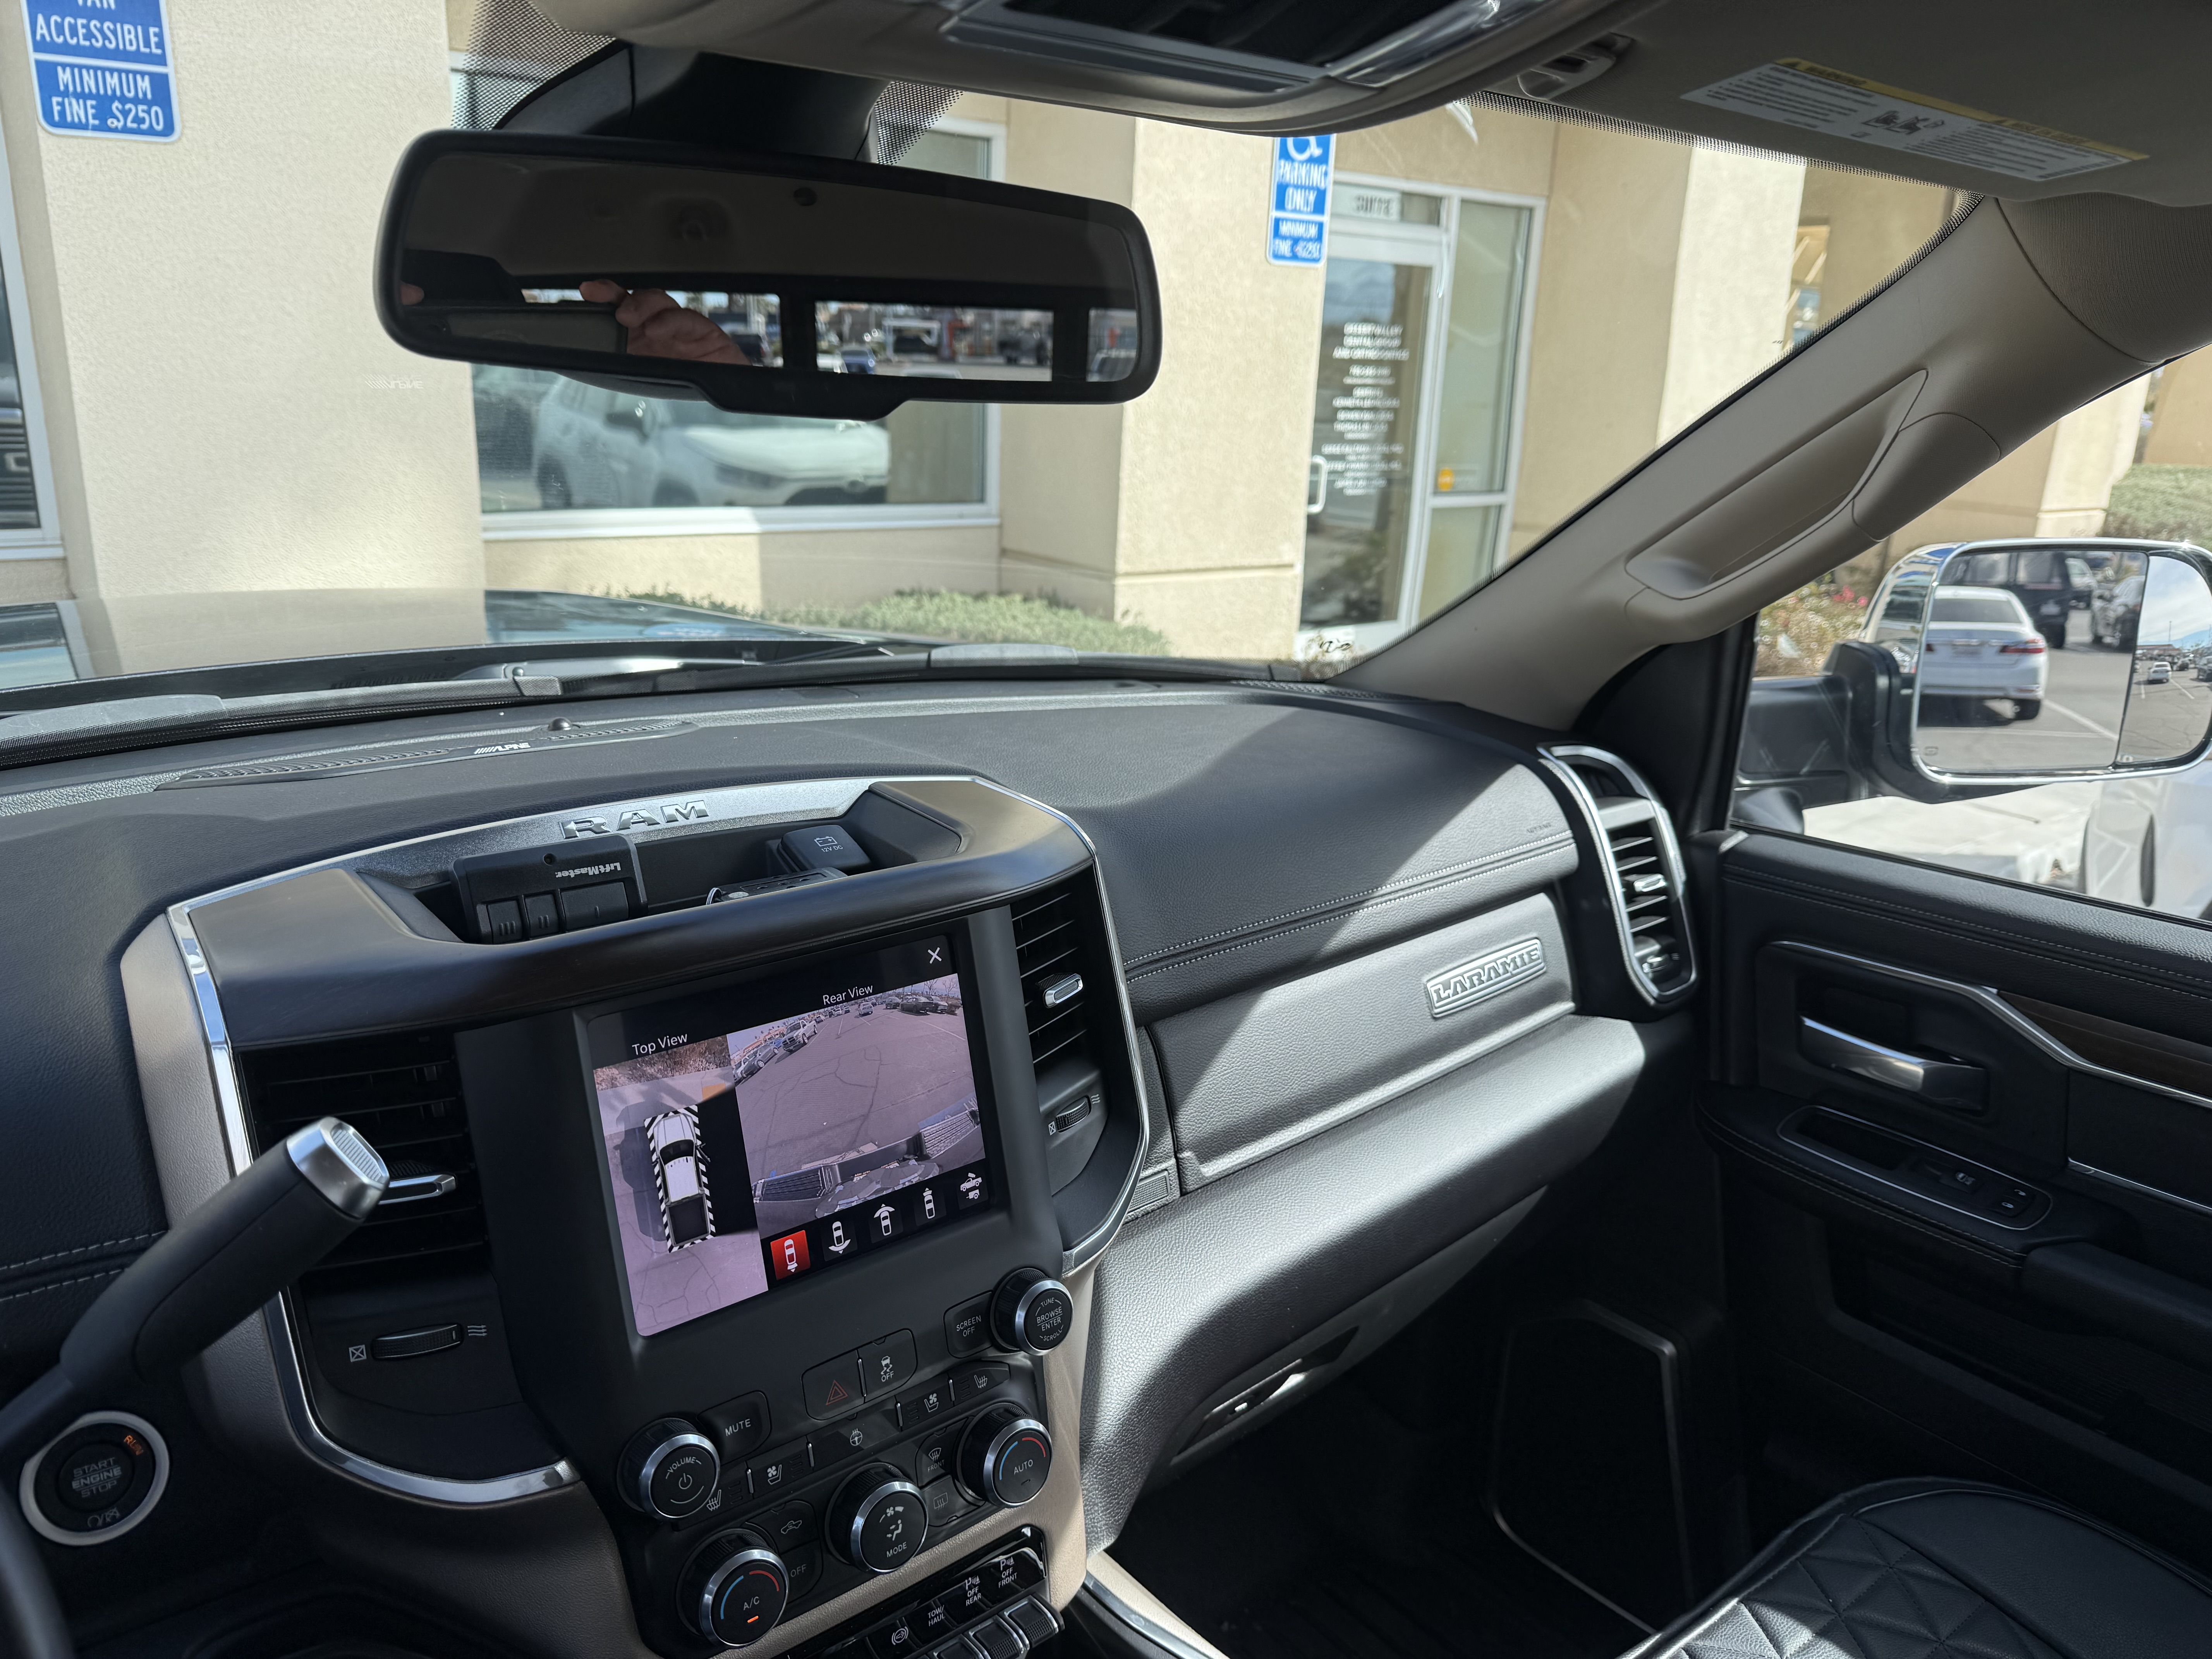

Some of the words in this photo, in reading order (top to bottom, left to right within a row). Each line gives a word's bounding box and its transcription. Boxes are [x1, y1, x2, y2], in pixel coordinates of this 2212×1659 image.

[35, 13, 163, 55] ACCESSIBLE
[57, 66, 152, 100] MINIMUM
[51, 96, 100, 125] FINE
[111, 100, 164, 131] $250
[559, 800, 709, 839] RAM
[1434, 948, 1540, 1003] LARAMIE
[823, 994, 848, 1005] Rear
[848, 985, 873, 998] View
[632, 1043, 656, 1056] Top
[658, 1033, 688, 1049] View
[1040, 1297, 1055, 1308] TUNE
[956, 1315, 981, 1331] SCREEN
[1036, 1306, 1063, 1324] BROWSE
[963, 1326, 975, 1337] OFF
[1041, 1317, 1061, 1331] ENTER
[1043, 1329, 1063, 1342] SCROLL
[881, 1371, 894, 1382] OFF
[725, 1418, 751, 1437] MUTE
[124, 1435, 144, 1456] RUN
[73, 1457, 115, 1478] START
[667, 1456, 697, 1474] VOLUME
[927, 1459, 945, 1472] FRONT
[1013, 1459, 1034, 1475] AUTO
[71, 1466, 122, 1489] ENGINE
[81, 1480, 117, 1498] STOP
[886, 1542, 907, 1558] MODE
[790, 1563, 807, 1578] OFF
[1001, 1567, 1013, 1578] OFF
[998, 1572, 1018, 1589] FRONT
[966, 1592, 981, 1606] REAR
[967, 1586, 979, 1597] OFF
[743, 1596, 759, 1611] A/C
[927, 1604, 945, 1619] TOW/
[928, 1613, 945, 1627] HAUL
